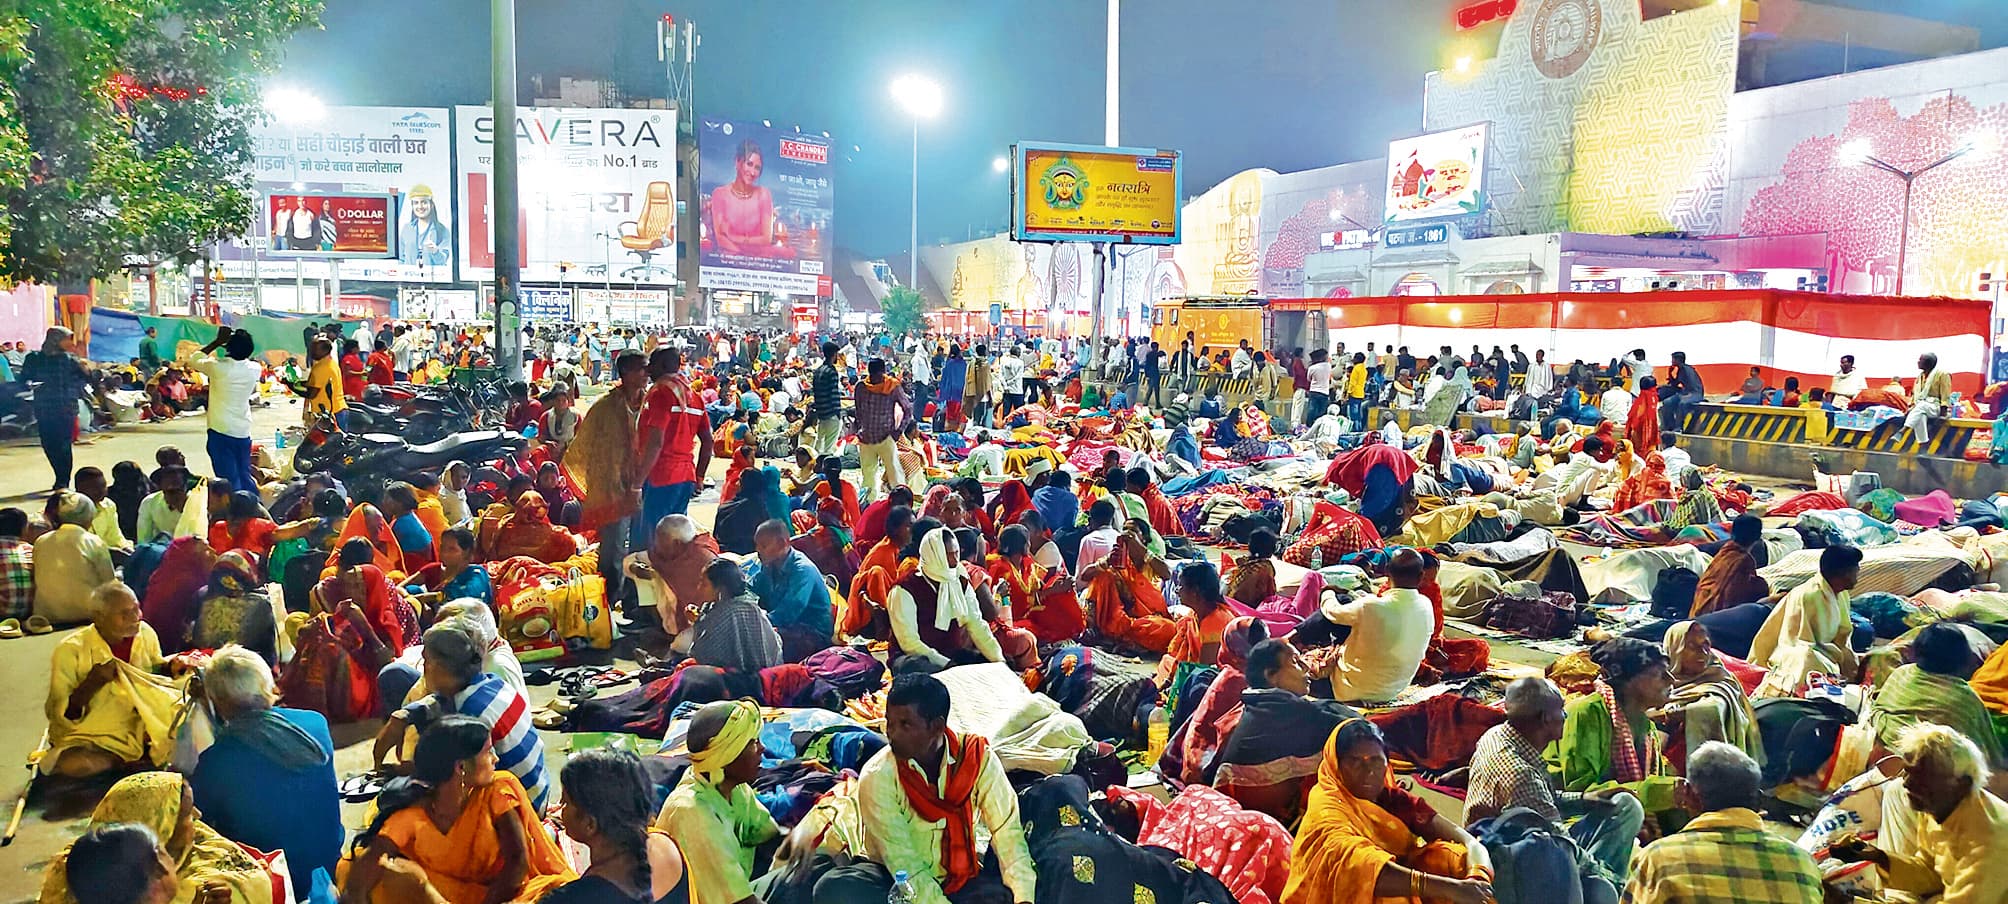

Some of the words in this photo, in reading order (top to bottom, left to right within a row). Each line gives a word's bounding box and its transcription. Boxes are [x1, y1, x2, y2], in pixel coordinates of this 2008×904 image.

[474, 117, 661, 147] SAVERA
[296, 133, 322, 152] सही
[326, 133, 365, 156] चौड़ाई
[368, 135, 402, 154] वाली
[404, 139, 427, 154] छत
[796, 143, 825, 155] CHANDRA
[300, 160, 312, 171] जो
[314, 160, 330, 171] करे
[332, 161, 353, 173] बचत
[355, 160, 403, 173] सालोसाल
[603, 154, 637, 168] No.1
[1107, 181, 1151, 194] नवरात्रि
[347, 209, 384, 219] DOLLAR
[531, 291, 570, 307] क्लिनिक
